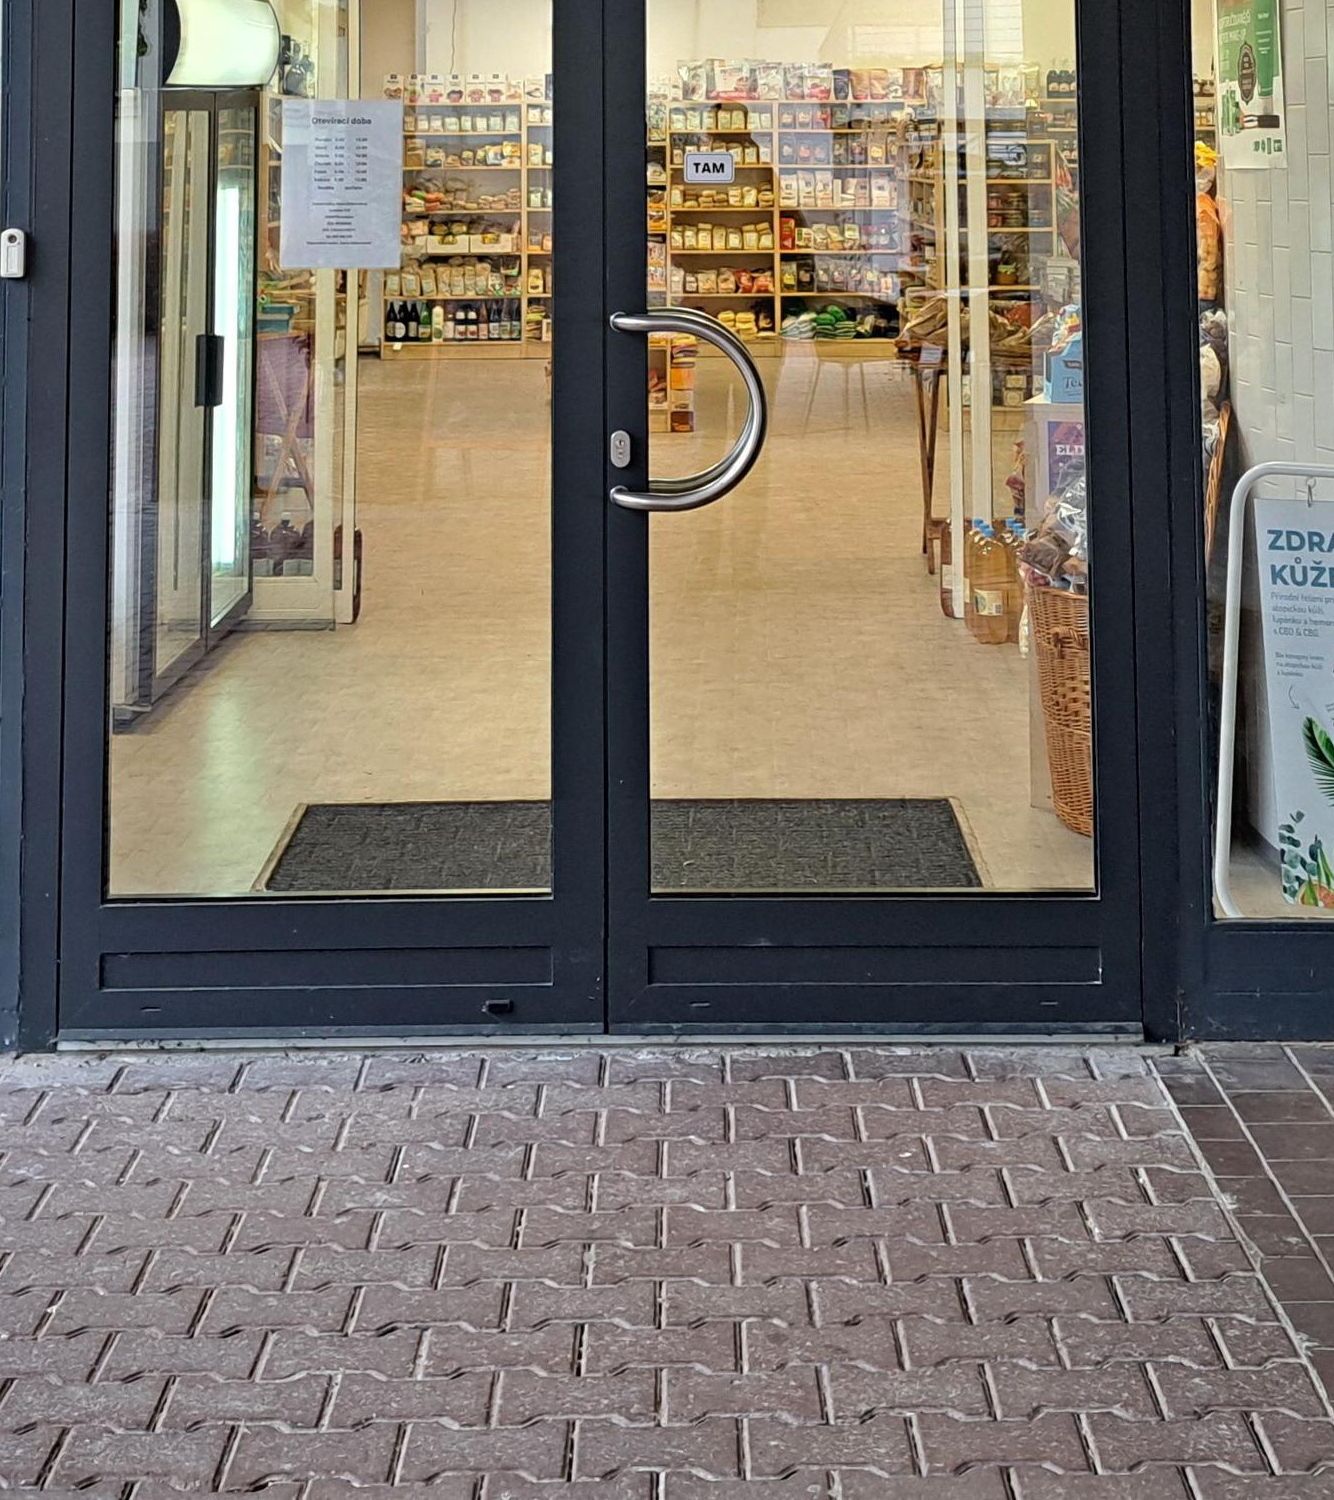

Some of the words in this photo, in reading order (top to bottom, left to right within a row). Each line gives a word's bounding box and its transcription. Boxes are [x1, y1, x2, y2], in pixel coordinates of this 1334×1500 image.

[311, 117, 349, 125] Otevírací
[351, 117, 371, 125] doba
[693, 162, 724, 173] TAM
